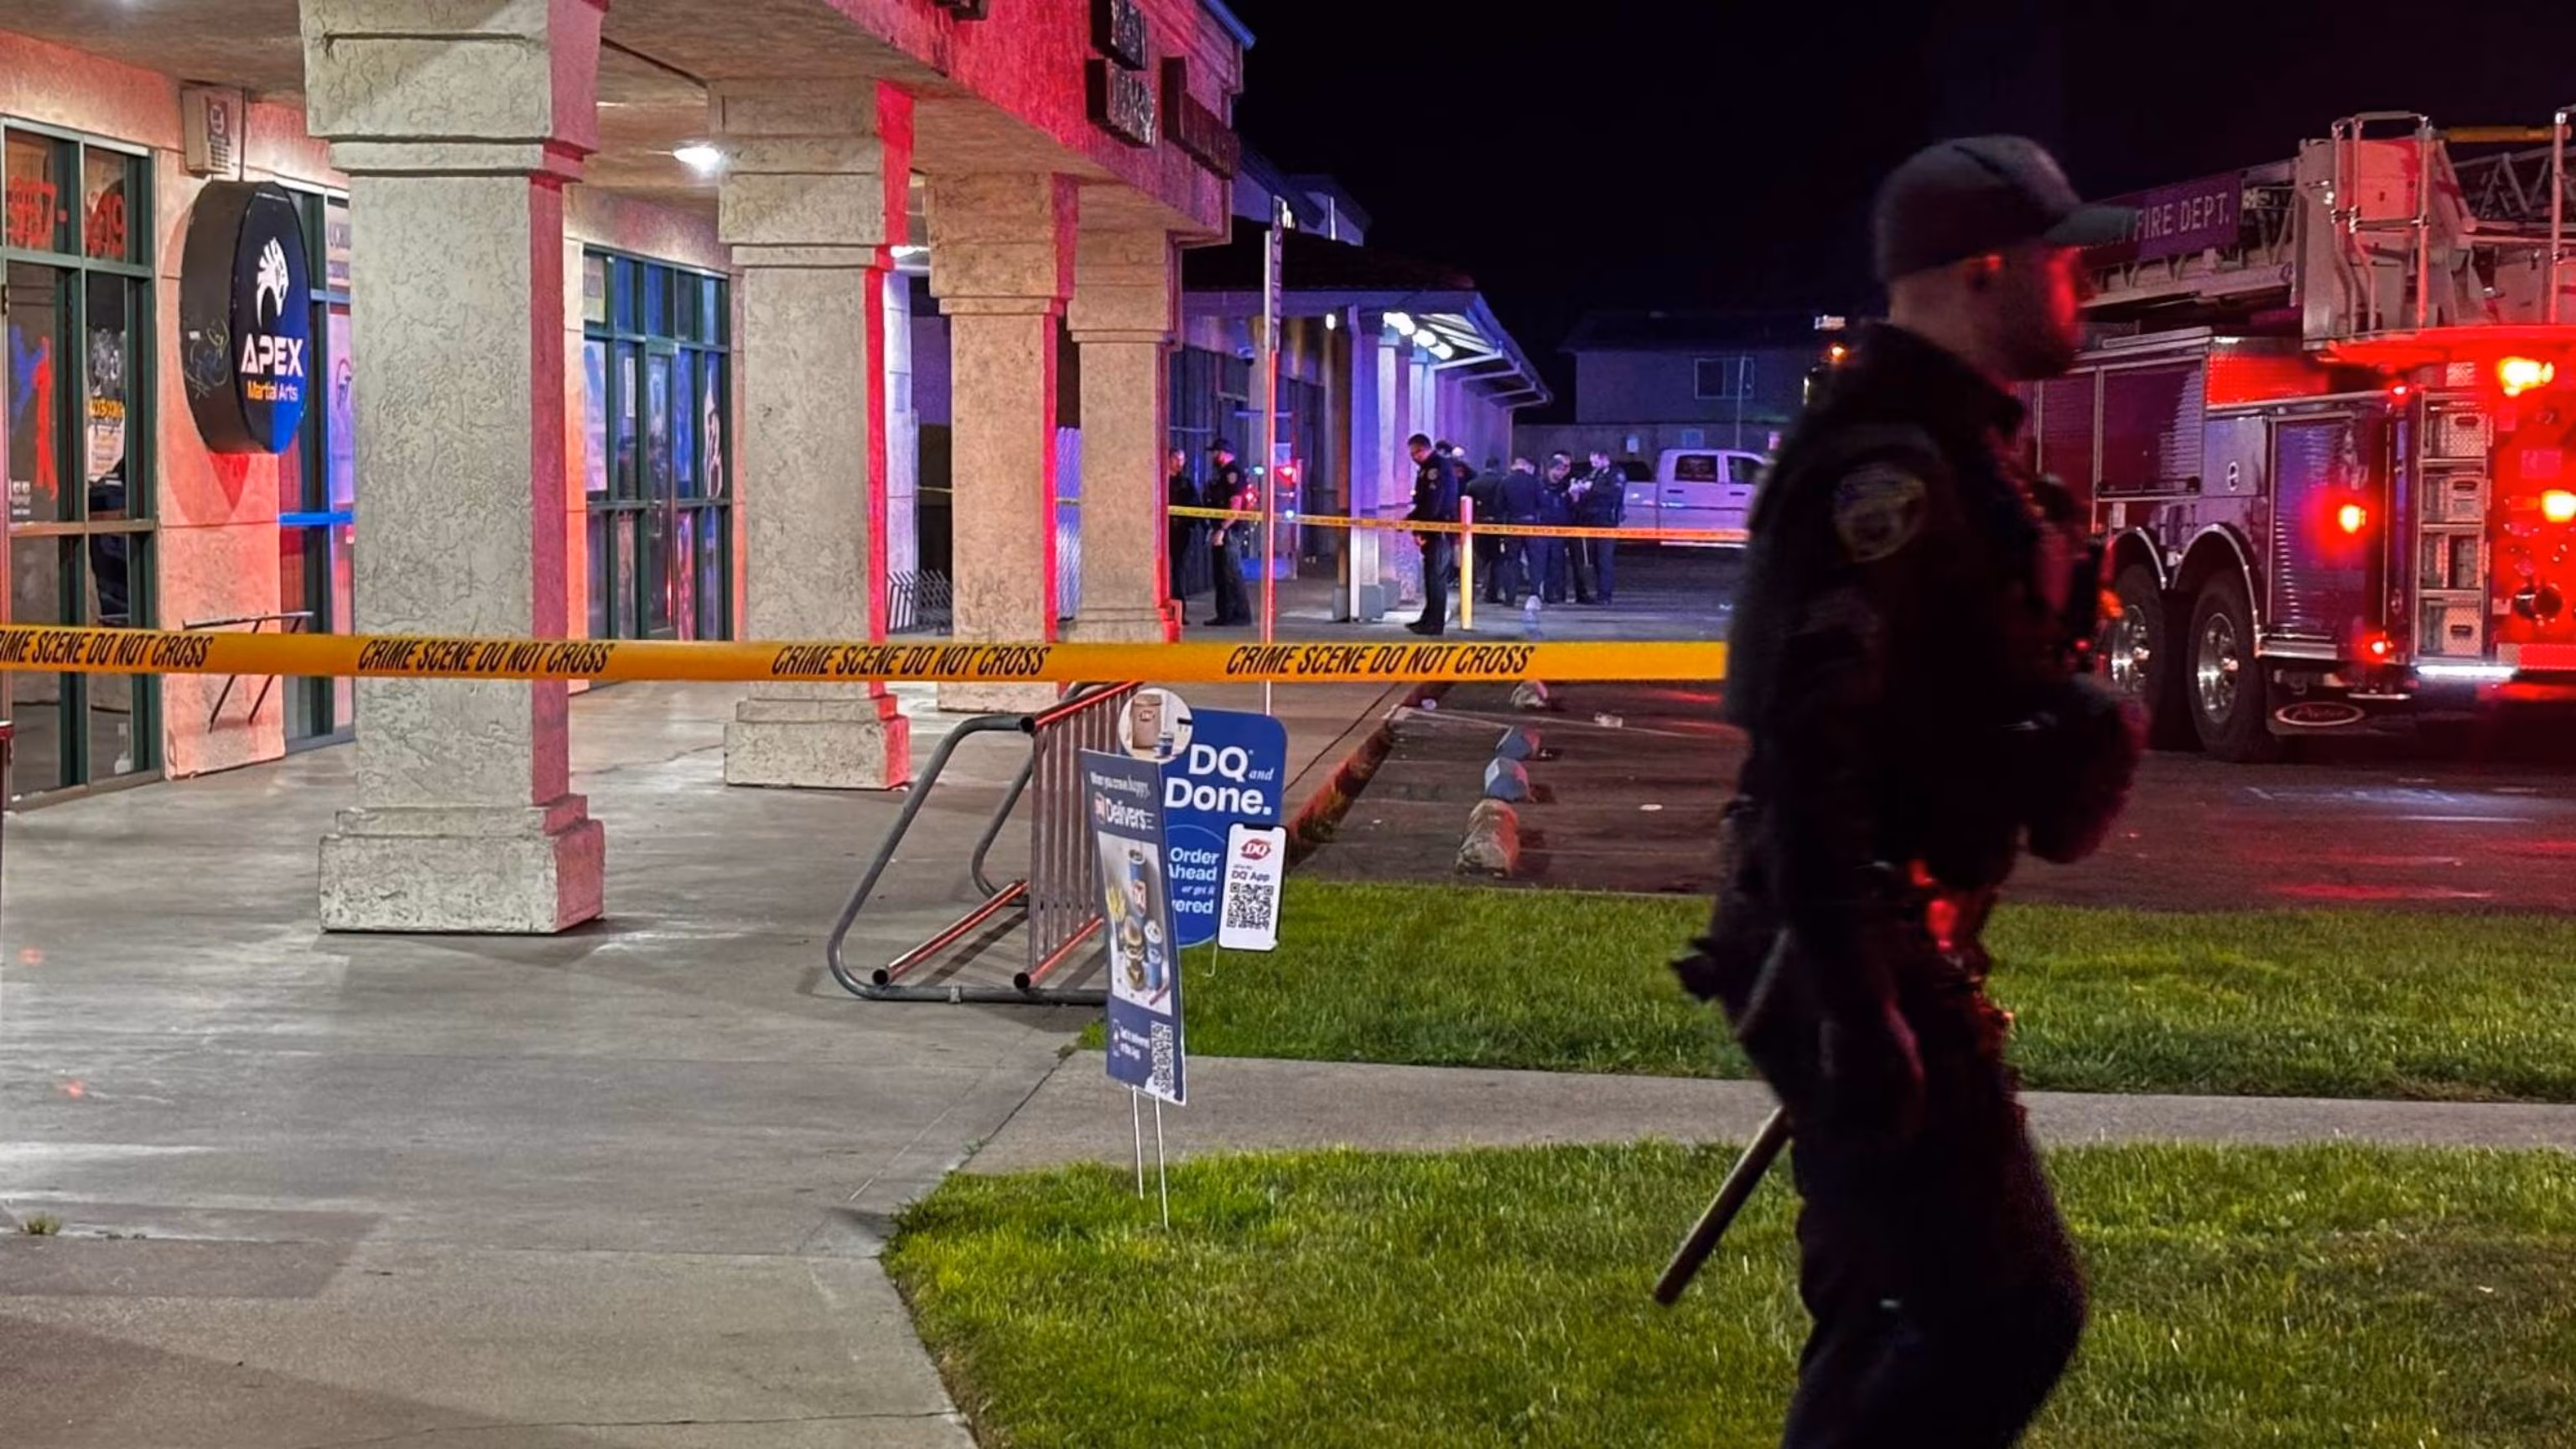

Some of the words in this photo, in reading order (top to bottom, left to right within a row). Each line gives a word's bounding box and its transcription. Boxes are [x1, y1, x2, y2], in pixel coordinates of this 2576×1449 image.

[2133, 204, 2174, 242] FIRE
[2180, 192, 2230, 233] DEPT.
[241, 333, 304, 377] APEX
[247, 380, 278, 401] Martial
[278, 382, 299, 402] Arts
[32, 631, 91, 664] SCENE
[86, 633, 117, 666] DO
[113, 633, 156, 666] NOT
[151, 635, 214, 668] CROSS
[358, 639, 422, 670] CRIME
[417, 640, 480, 671] SCENE
[475, 641, 508, 672] DO
[505, 641, 550, 673] NOT
[546, 642, 614, 673] CROSS
[771, 645, 841, 675] CRIME
[837, 646, 906, 675] SCENE
[900, 646, 937, 675] DO
[932, 646, 984, 676] NOT
[977, 646, 1051, 676] CROSS
[1225, 645, 1301, 675] CRIME
[1298, 645, 1373, 675] SCENE
[1367, 646, 1408, 674] DO
[1404, 646, 1457, 675] NOT
[1453, 646, 1535, 675] CROSS
[1249, 767, 1275, 781] and
[1164, 776, 1273, 816] Done.
[1170, 846, 1220, 865] Order
[1231, 870, 1248, 880] DQ
[1249, 871, 1270, 883] App
